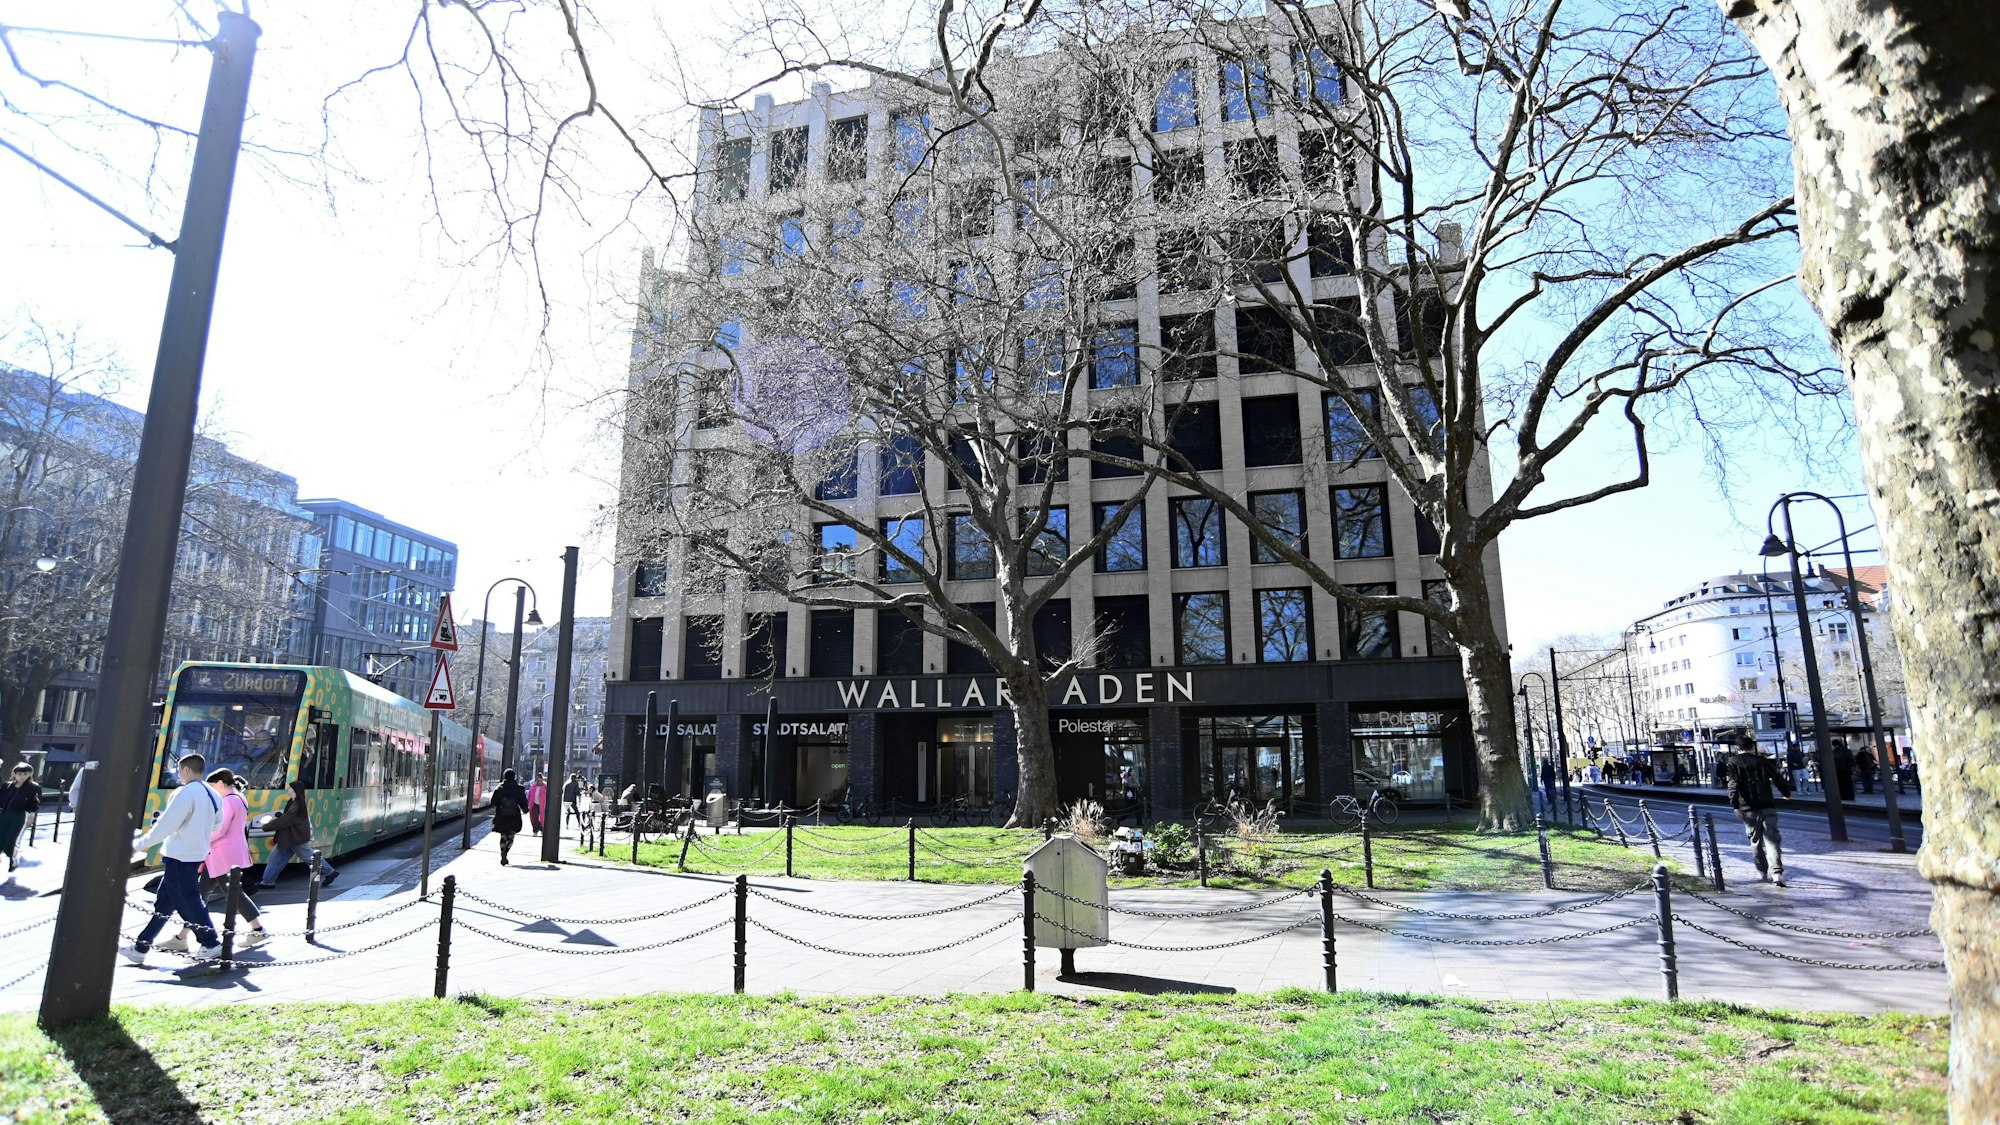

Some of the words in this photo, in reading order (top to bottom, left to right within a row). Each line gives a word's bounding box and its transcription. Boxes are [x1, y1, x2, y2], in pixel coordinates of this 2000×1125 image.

[223, 672, 289, 691] Zündorf
[837, 671, 1194, 708] WALLARADEN
[752, 722, 845, 735] STDTSALAT
[1059, 719, 1116, 733] Polestar
